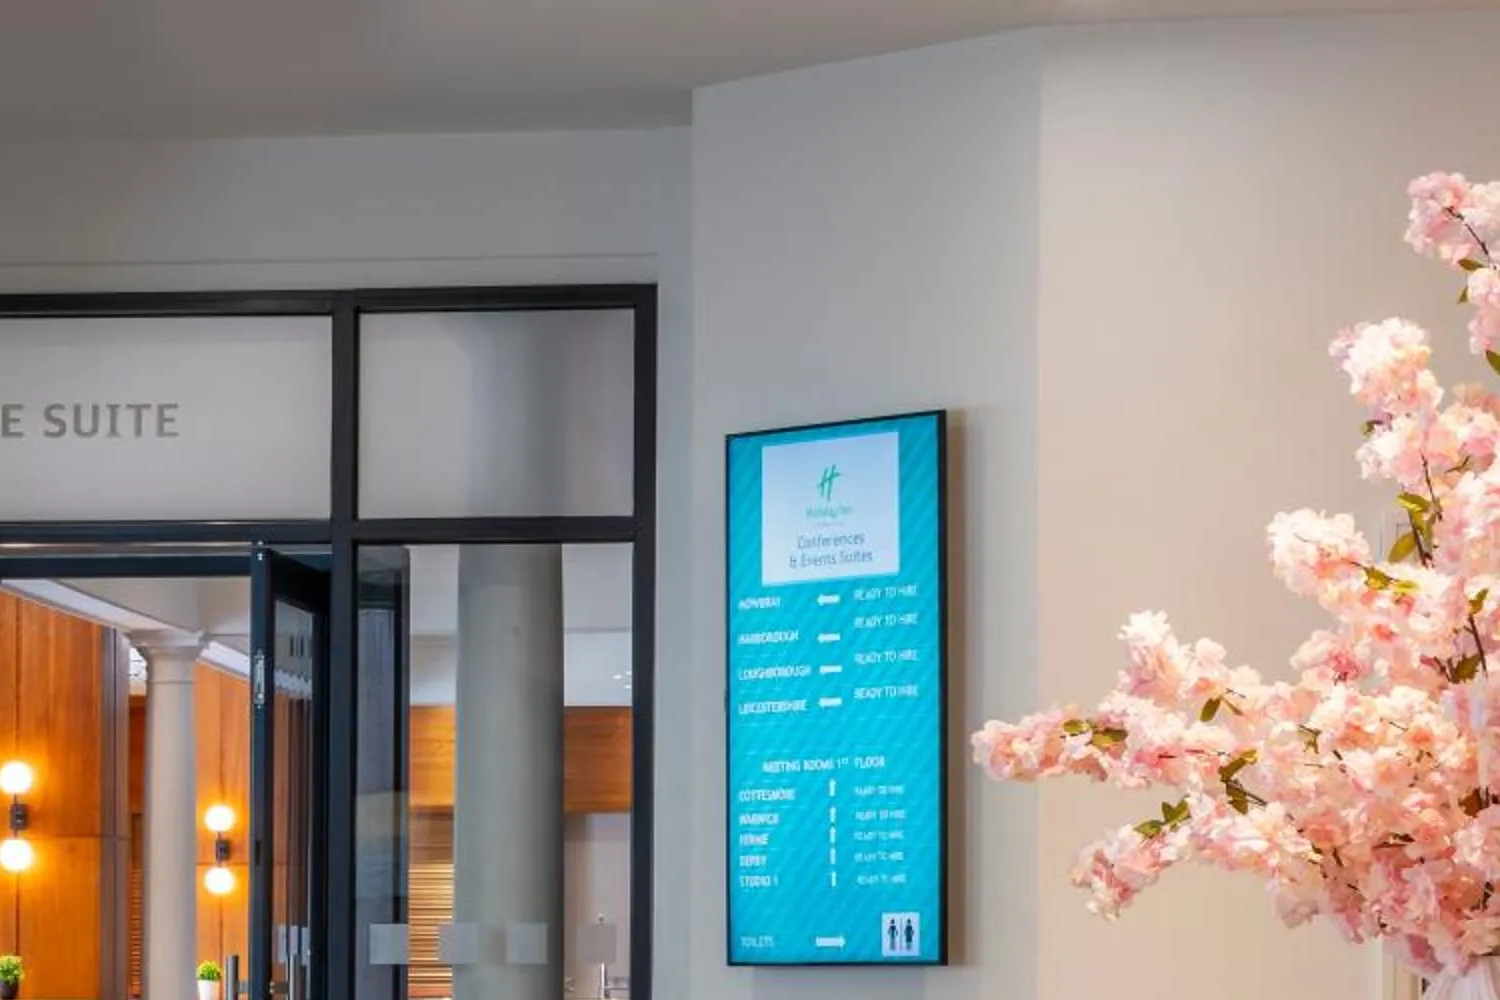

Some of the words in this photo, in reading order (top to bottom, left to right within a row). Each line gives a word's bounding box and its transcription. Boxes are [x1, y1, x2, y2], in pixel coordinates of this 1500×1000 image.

[43, 403, 179, 438] SUITE
[797, 532, 866, 549] Conferences
[800, 553, 837, 569] Events
[840, 550, 873, 564] Suites
